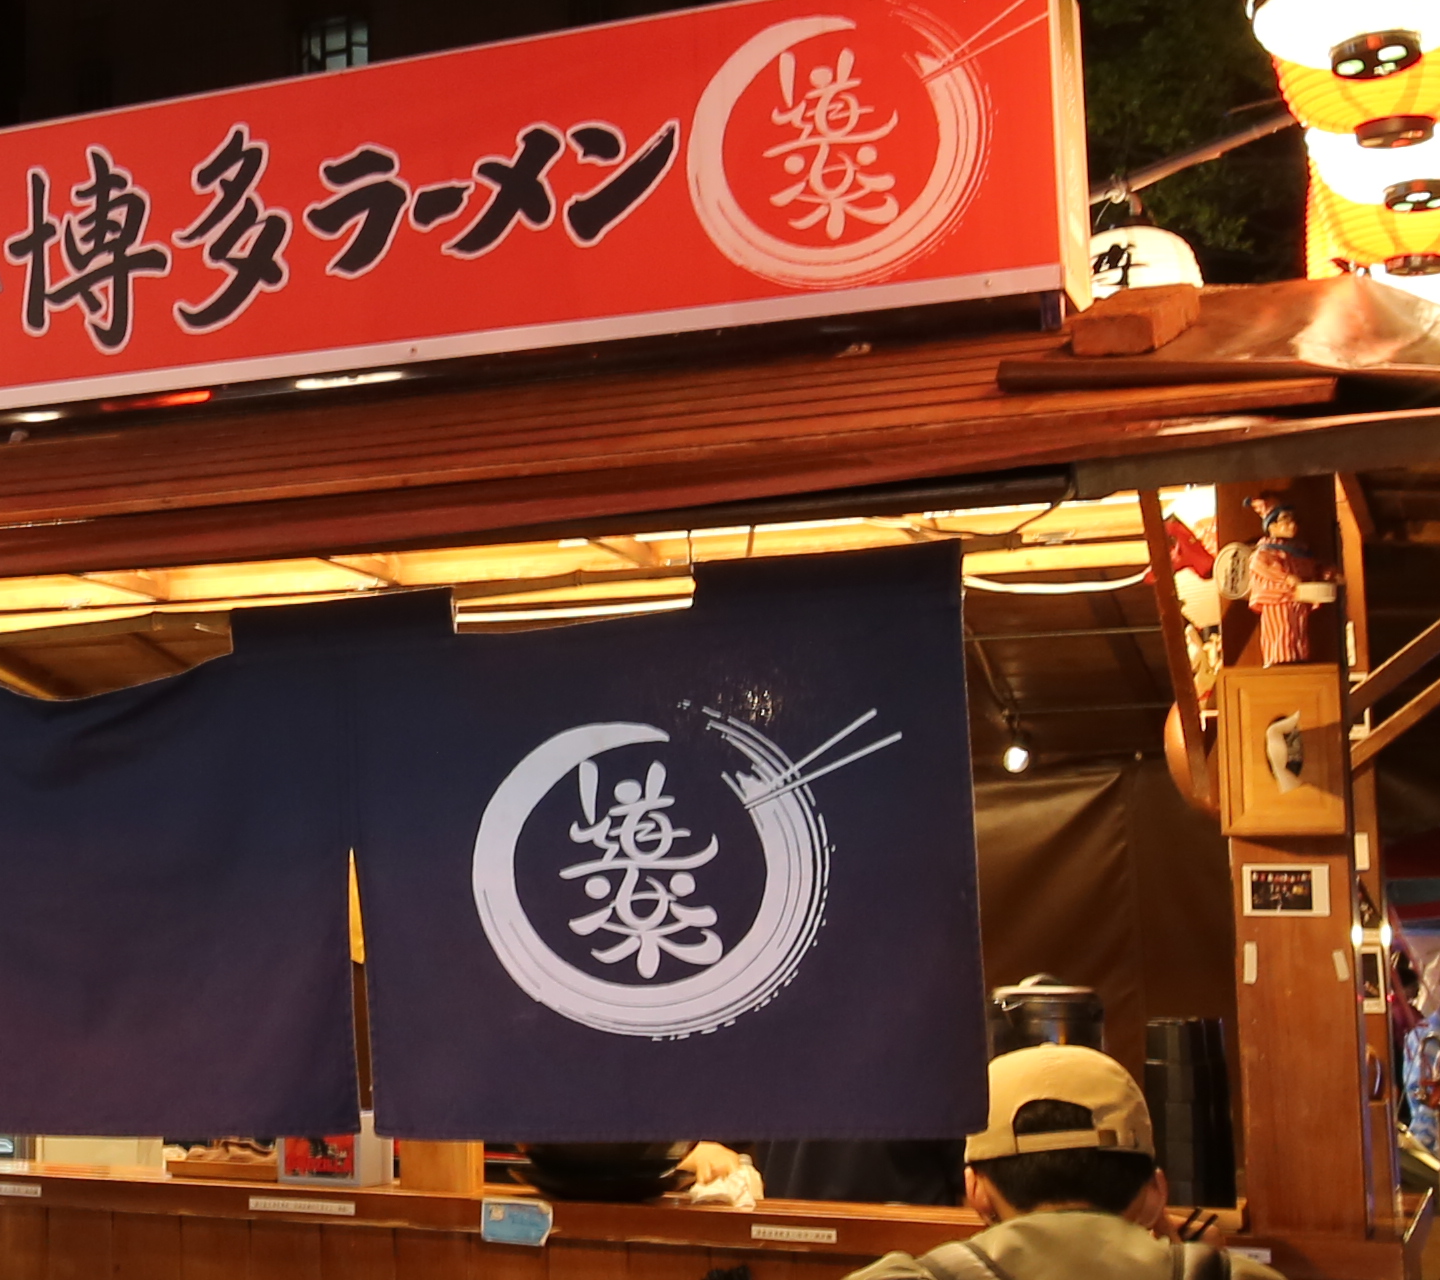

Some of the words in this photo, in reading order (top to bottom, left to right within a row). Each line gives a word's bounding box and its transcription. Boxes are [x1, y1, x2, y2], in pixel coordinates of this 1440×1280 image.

[6, 121, 678, 352] 博多ラーメン
